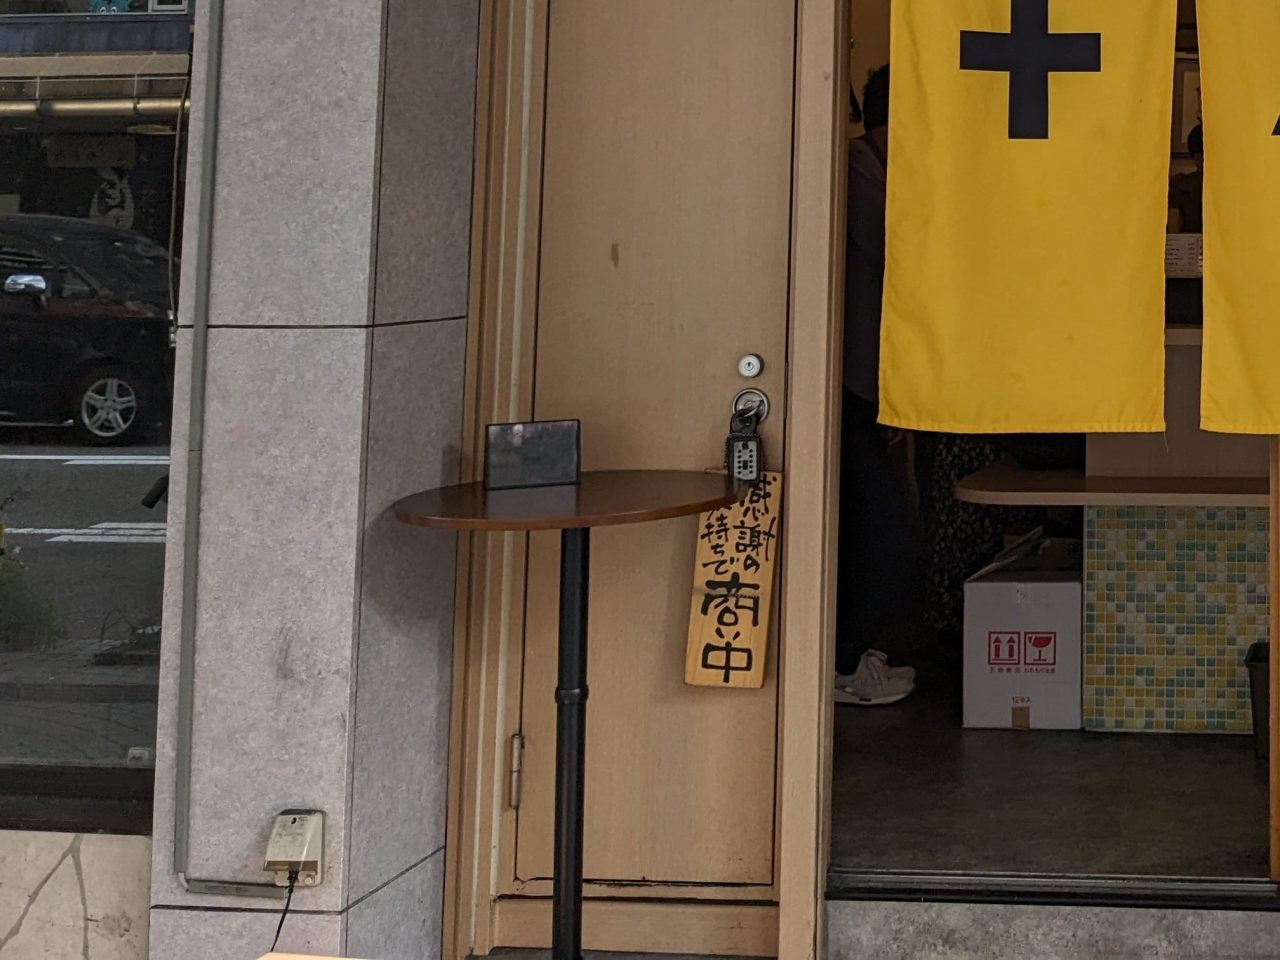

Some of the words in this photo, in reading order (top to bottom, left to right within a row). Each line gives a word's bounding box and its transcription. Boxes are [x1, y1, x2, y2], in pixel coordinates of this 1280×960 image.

[700, 505, 741, 575] 持ちで
[701, 572, 761, 684] 商い中
